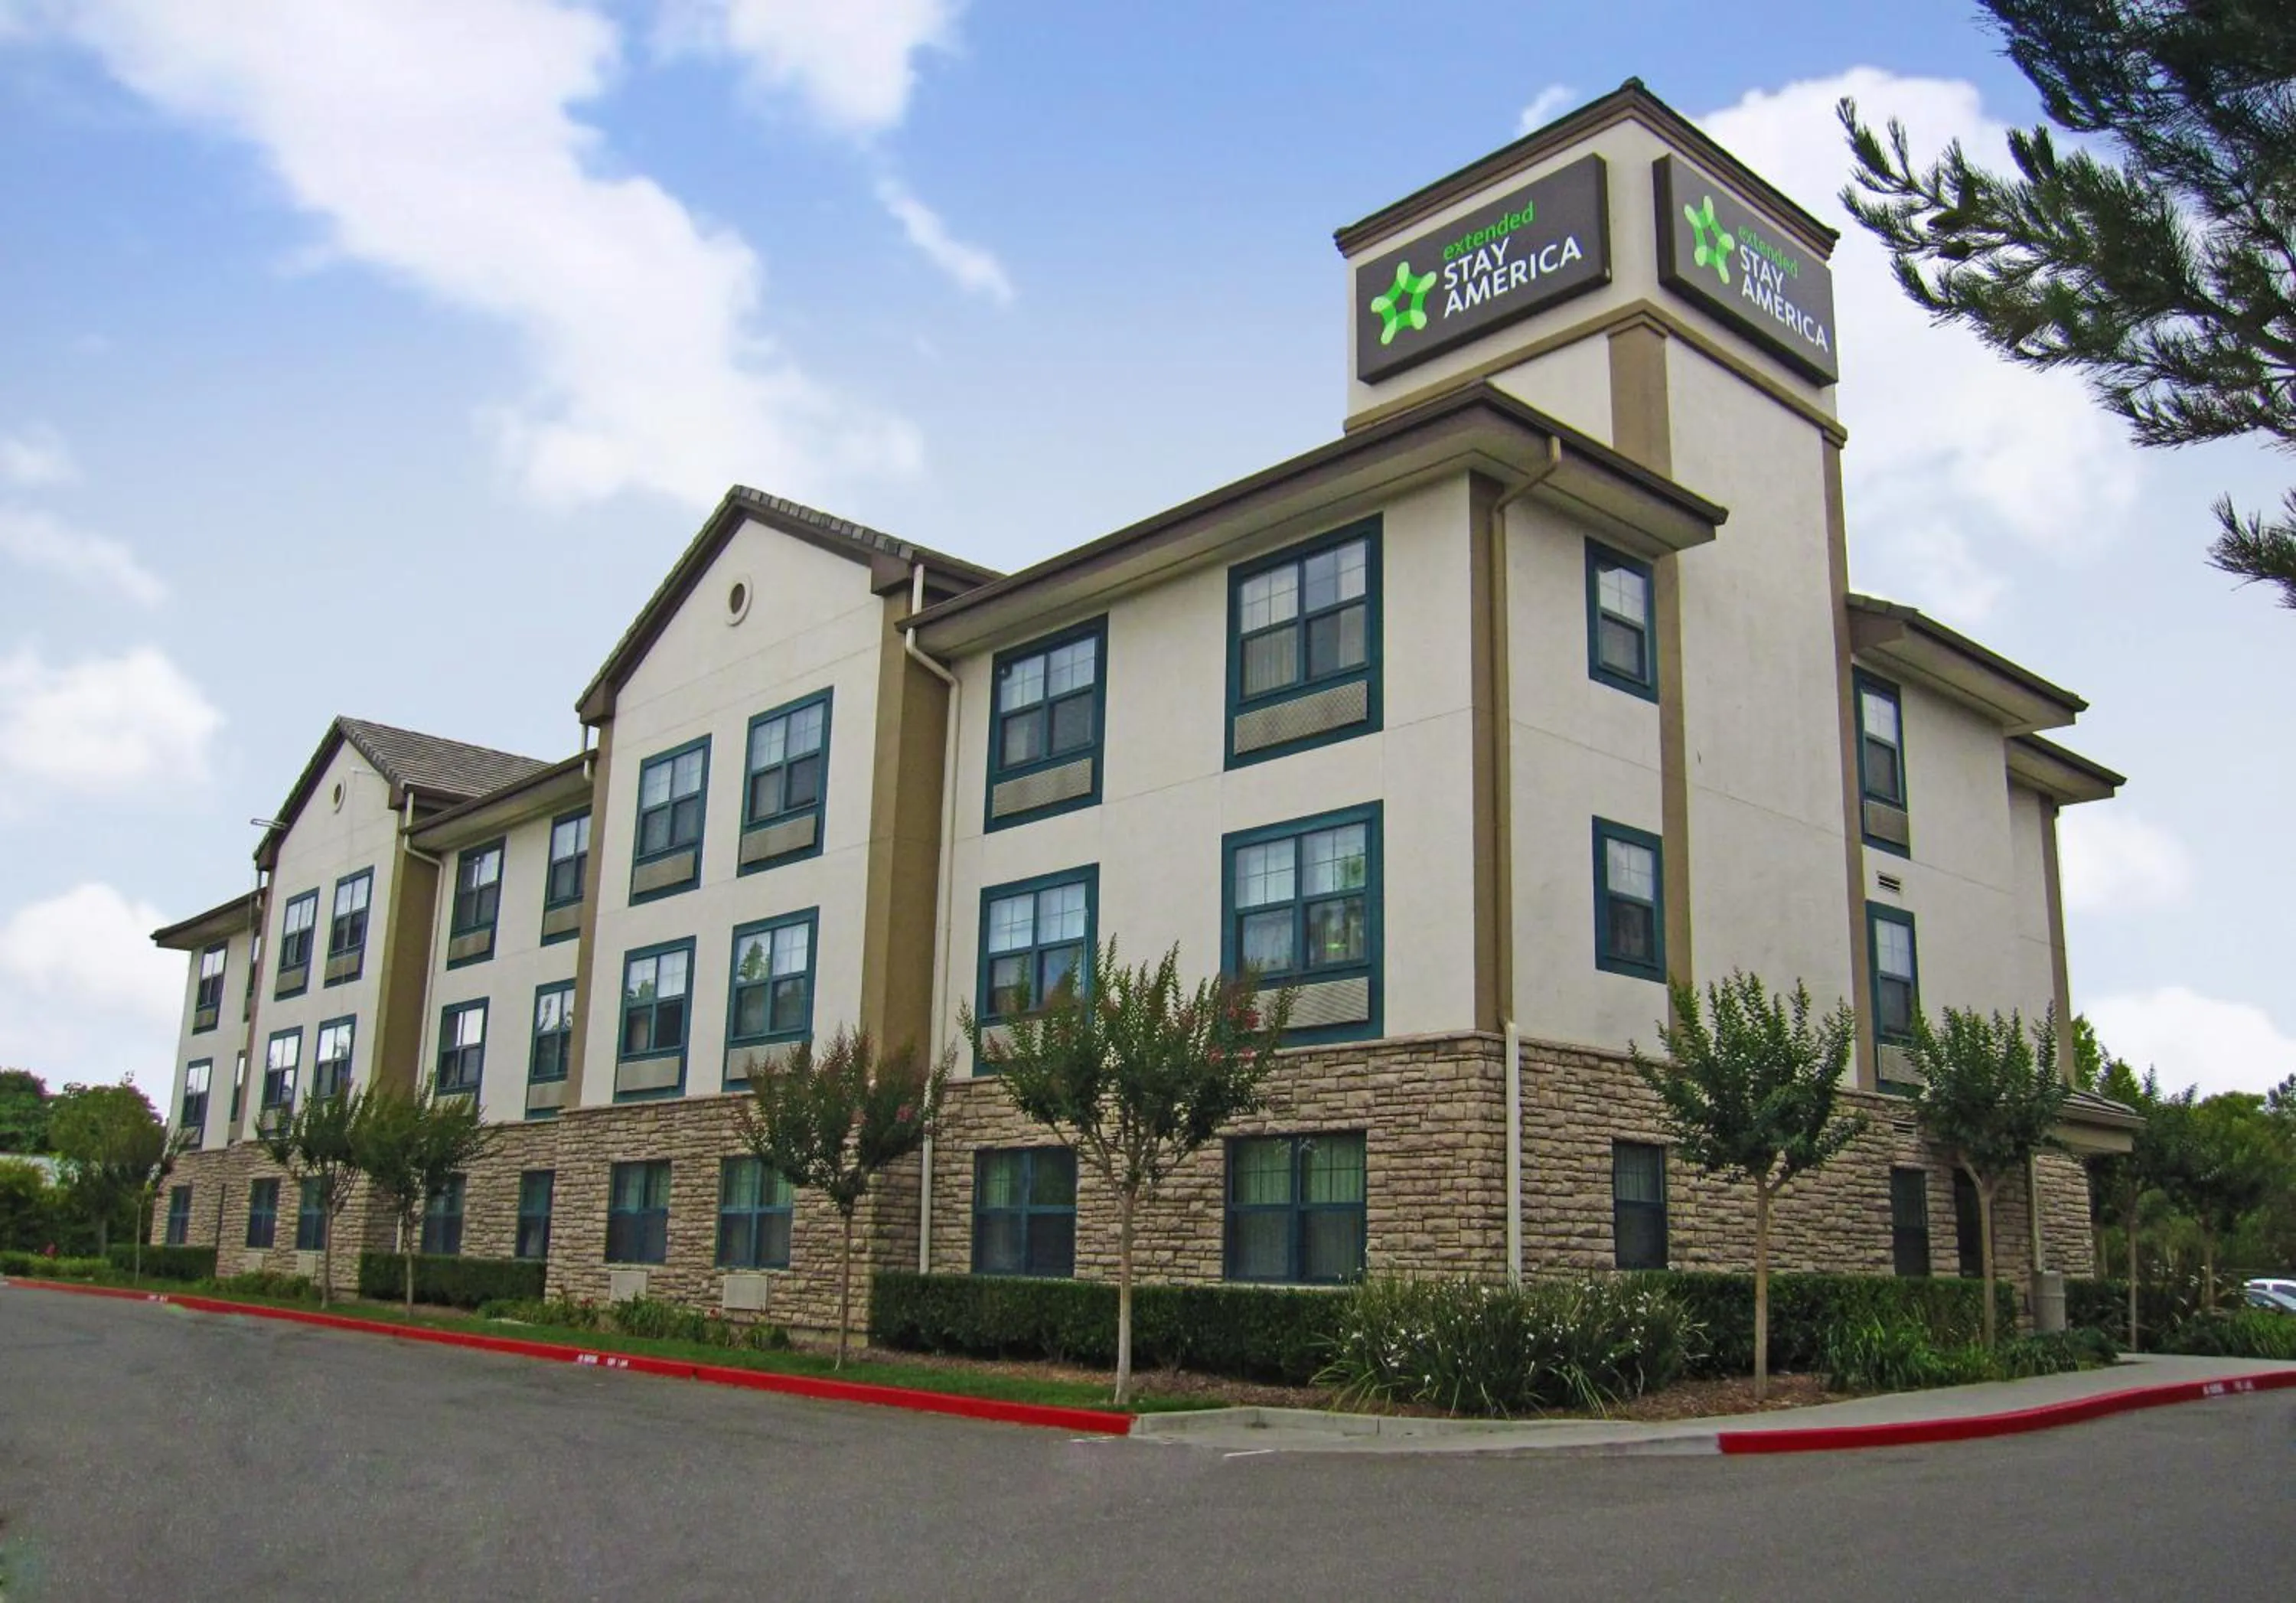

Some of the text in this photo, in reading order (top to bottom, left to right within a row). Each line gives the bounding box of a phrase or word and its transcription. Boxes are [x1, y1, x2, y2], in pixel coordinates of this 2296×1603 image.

[1444, 202, 1534, 260] extended
[1739, 227, 1797, 278] extended
[1444, 238, 1509, 290] STAY
[1444, 237, 1581, 318] AMERICA
[1740, 245, 1783, 292] STAY
[1742, 275, 1828, 351] AMERICA
